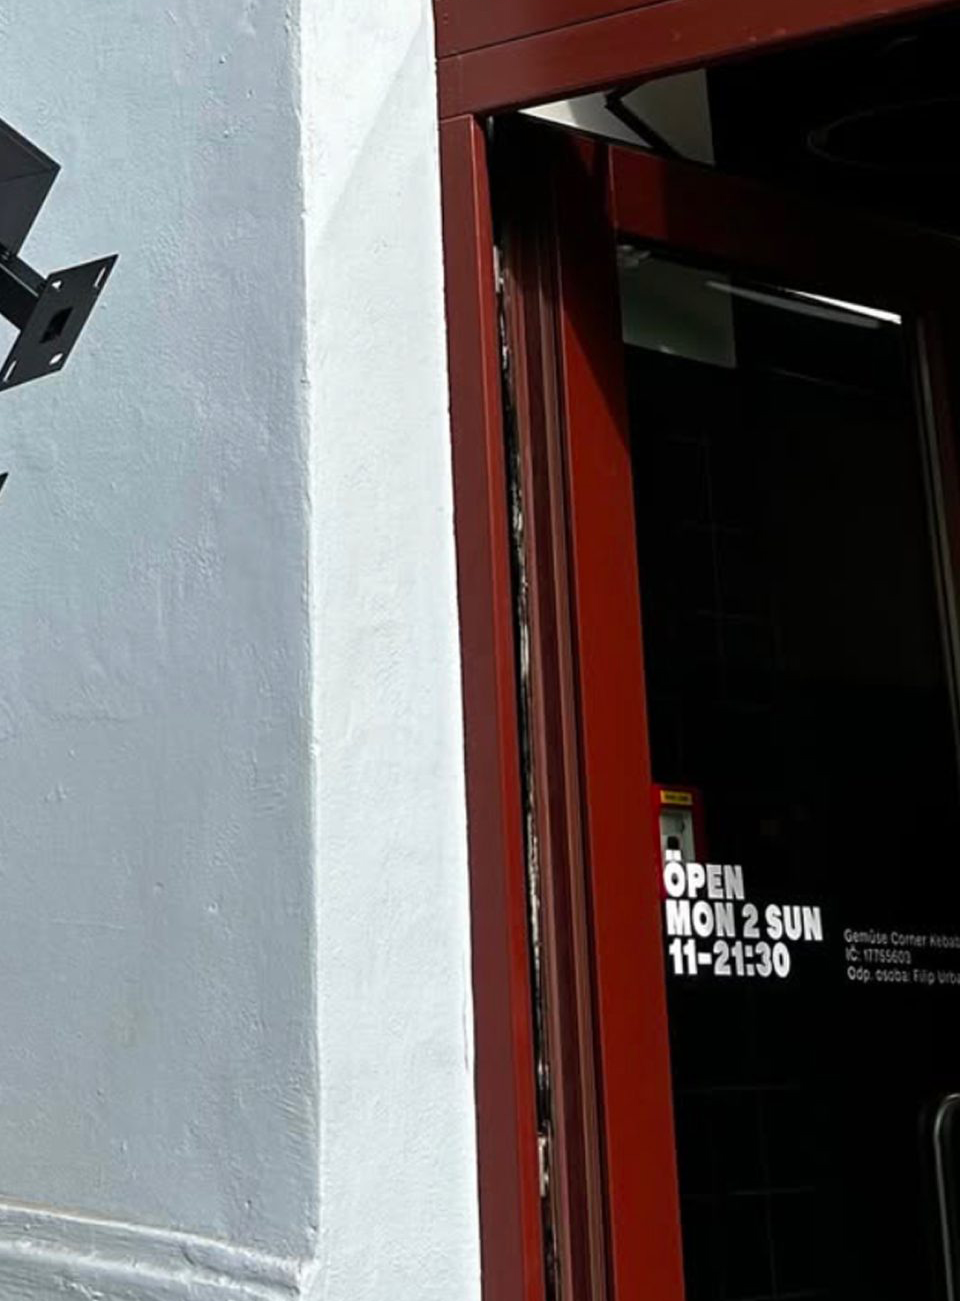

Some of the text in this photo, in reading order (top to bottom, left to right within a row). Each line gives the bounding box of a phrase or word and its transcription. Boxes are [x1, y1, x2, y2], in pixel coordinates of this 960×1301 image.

[665, 899, 823, 941] MON 2 SUN
[891, 932, 926, 947] Corner
[669, 938, 791, 978] 11-21:30
